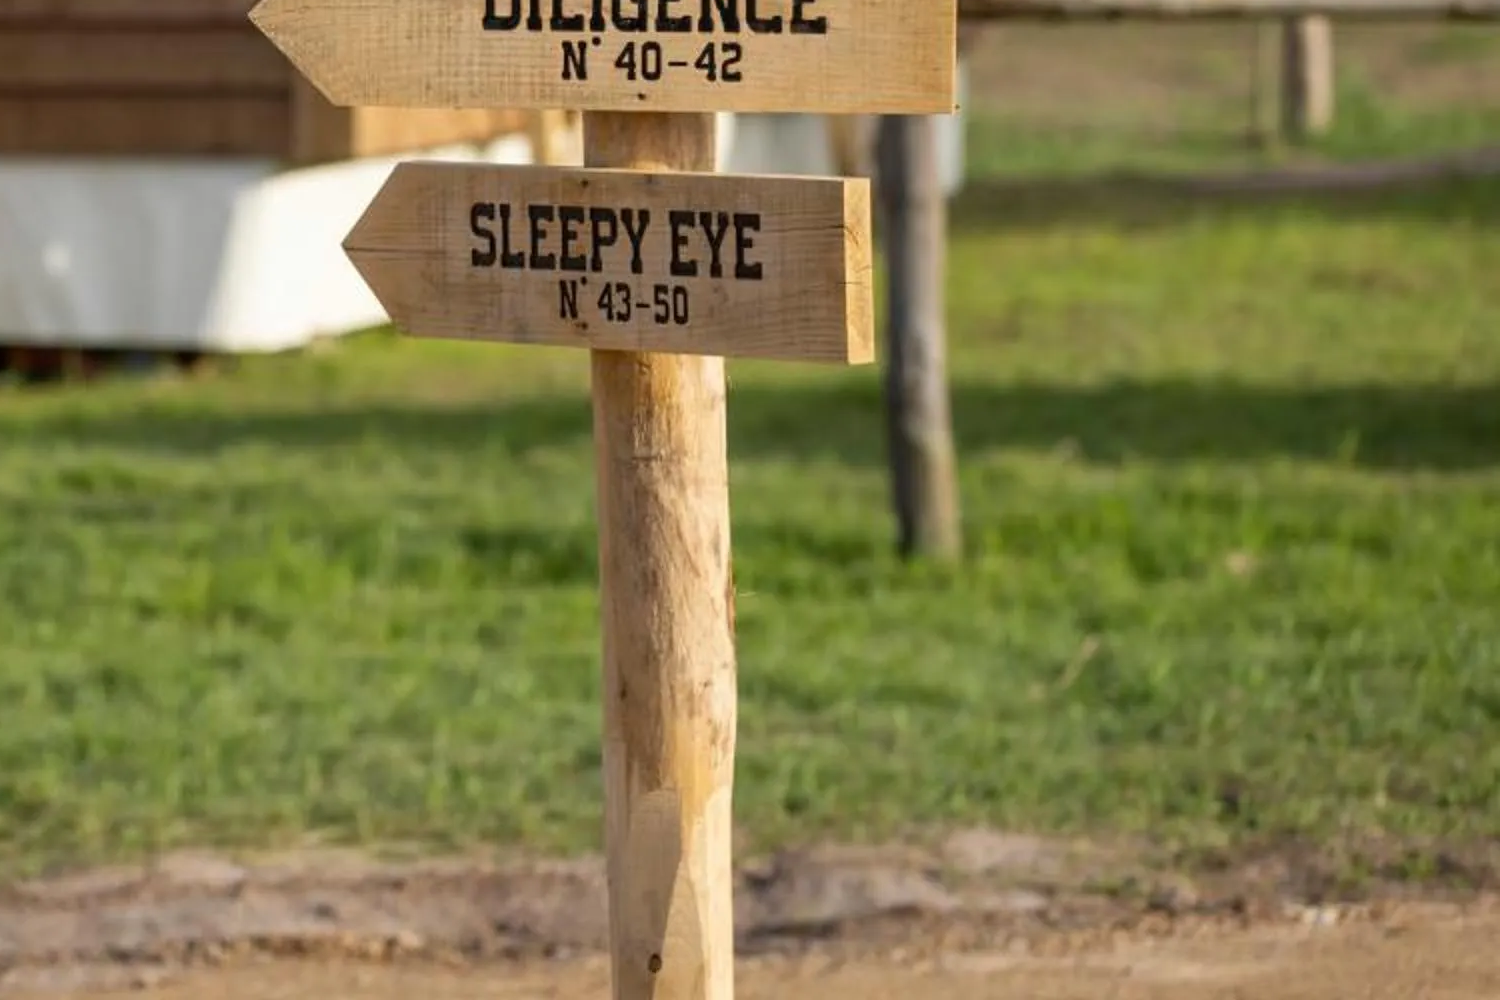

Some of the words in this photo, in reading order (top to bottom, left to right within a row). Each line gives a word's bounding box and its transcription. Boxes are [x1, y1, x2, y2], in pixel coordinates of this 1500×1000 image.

[614, 41, 743, 82] 40-42
[469, 201, 651, 276] SLEEPY
[667, 208, 765, 282] EYE
[596, 281, 691, 326] 43-50
